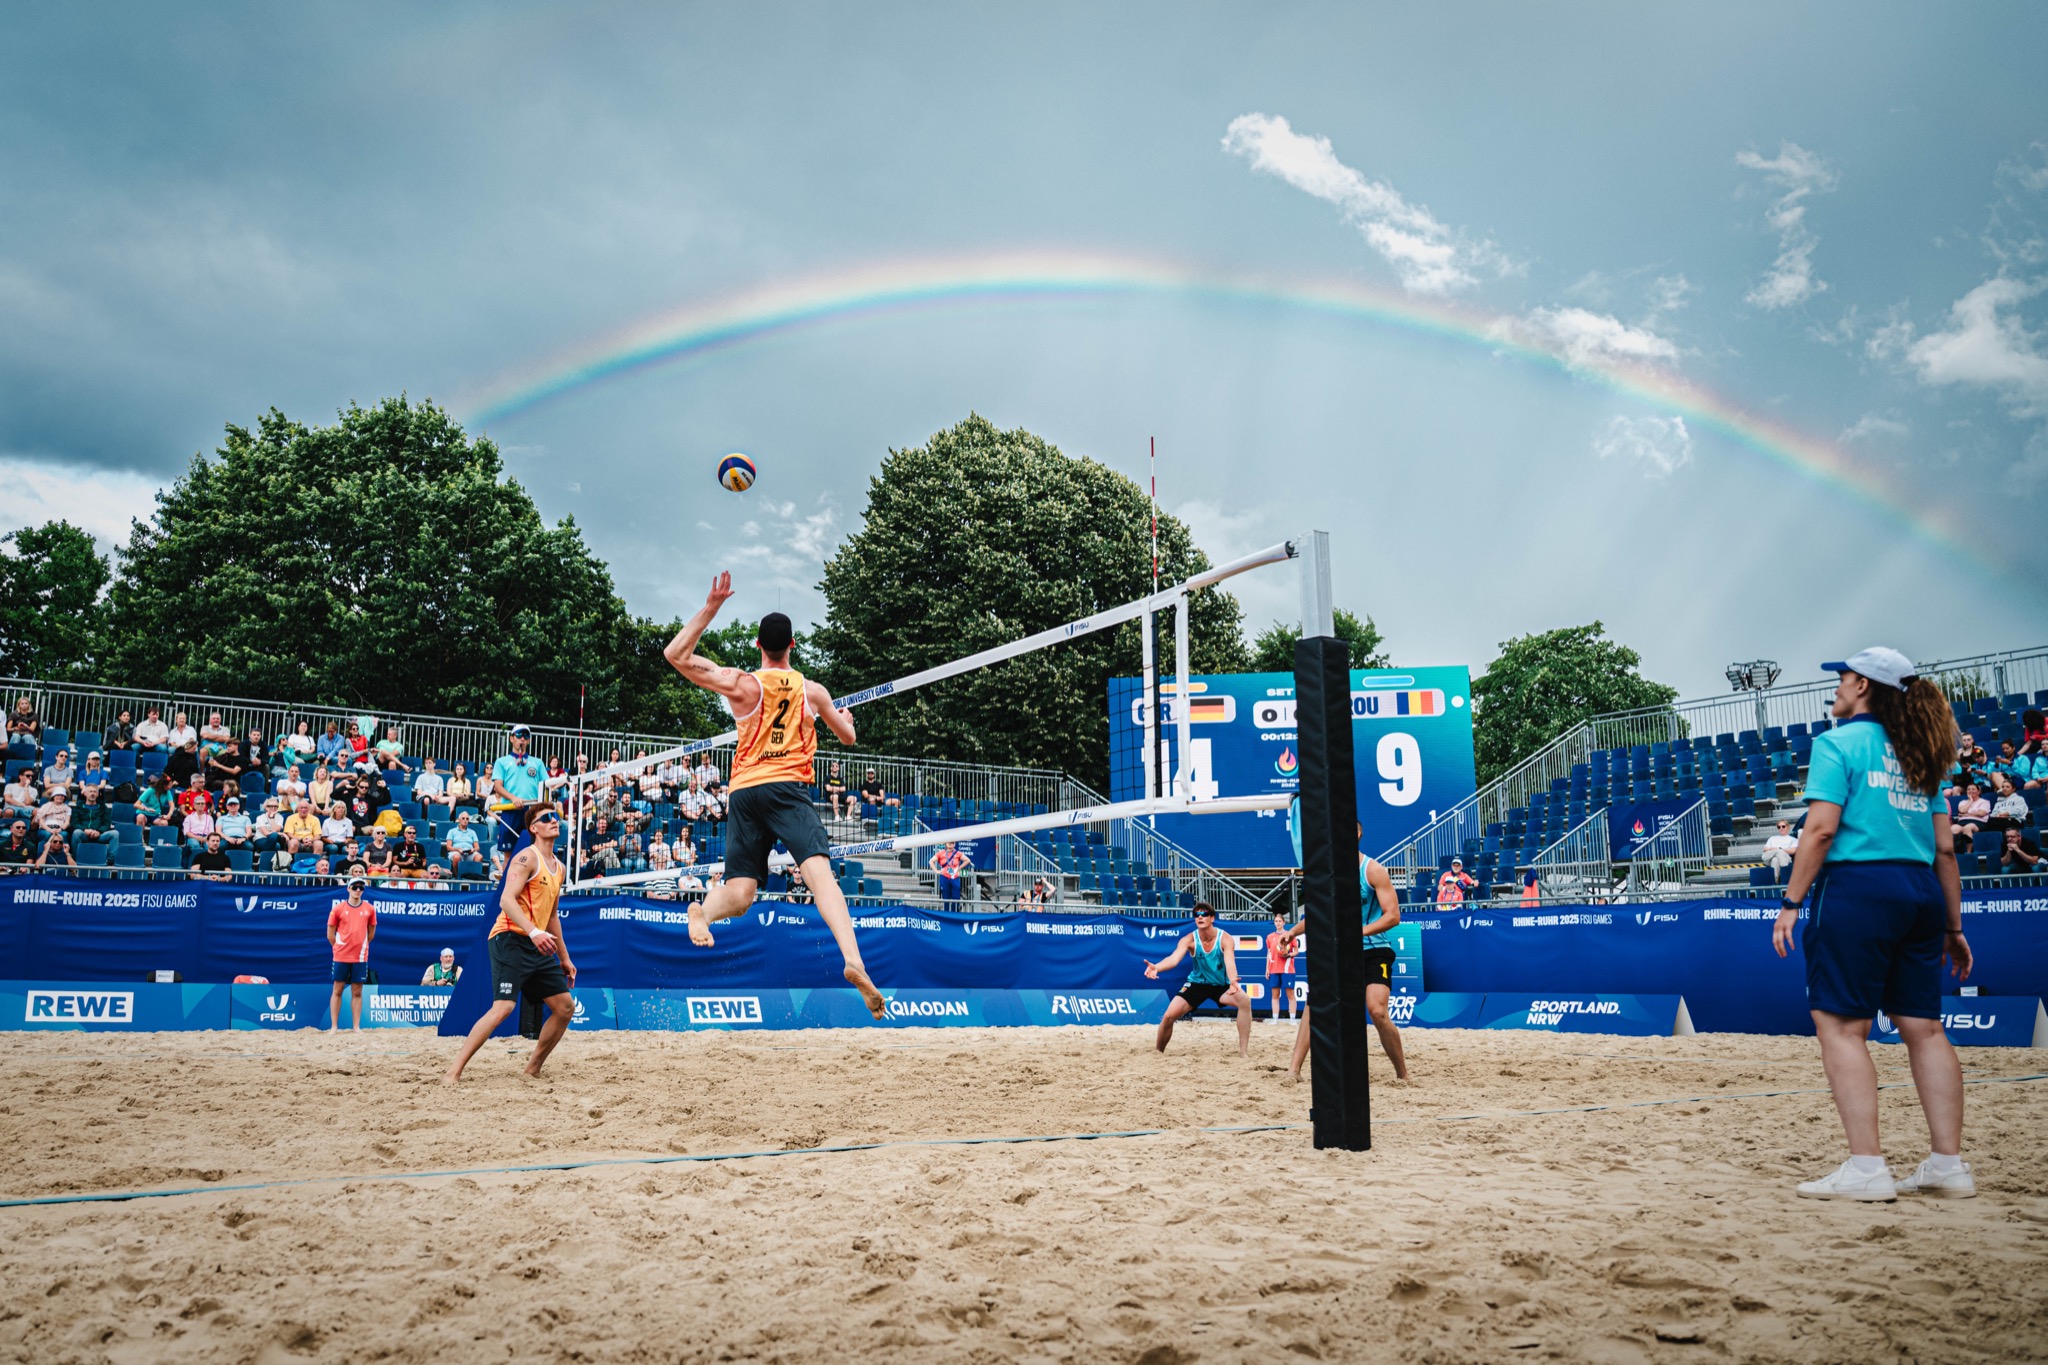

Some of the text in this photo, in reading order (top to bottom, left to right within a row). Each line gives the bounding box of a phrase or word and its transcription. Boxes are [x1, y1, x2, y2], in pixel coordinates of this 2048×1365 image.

[1075, 621, 1089, 632] FISU
[847, 688, 875, 704] UNIVERSITY
[875, 682, 894, 697] GAMES
[1266, 688, 1294, 696] SET
[772, 699, 790, 730] 2
[1262, 708, 1278, 723] 0
[771, 730, 784, 744] GER
[1261, 733, 1298, 741] 00:12:
[1376, 732, 1422, 807] 9
[1077, 811, 1093, 820] FISU
[846, 843, 875, 856] UNIVERSITY
[875, 840, 894, 851] GAMES
[13, 889, 197, 908] RHINE-RUHR 2025 FISU GAMES
[262, 900, 298, 911] FISU
[2024, 898, 2048, 912] 202
[408, 902, 437, 916] 2025
[439, 903, 457, 916] FISU
[458, 903, 485, 916] GAMES
[600, 907, 689, 924] RHINE-RUHR 2025
[1704, 909, 1780, 920] RHINE-RUHR 202
[777, 916, 805, 924] FISU
[885, 917, 907, 928] 2025
[907, 917, 920, 929] FISU
[921, 919, 941, 931] GAMES
[1426, 920, 1441, 930] GAMES
[1473, 919, 1494, 927] FISU
[1513, 914, 1612, 927] RHINE-RUHR 2025 FISU GAMES
[1654, 914, 1678, 922] FISU
[981, 925, 1004, 933] FISU
[1026, 922, 1124, 935] RHINE-RUHR 2025 FISU GAMES
[1398, 937, 1405, 950] 1
[1380, 963, 1388, 979] 1
[32, 995, 127, 1017] REWE
[370, 994, 451, 1009] RHINE-RUH
[890, 1001, 969, 1016] QIAODAN
[1078, 999, 1137, 1014] RIEDEL
[1530, 1000, 1621, 1014] SPORTLAND.
[370, 1010, 389, 1022] FISU
[390, 1010, 420, 1022] WORLD
[692, 1001, 757, 1019] REWE
[260, 1013, 296, 1022] FISU
[1526, 1012, 1564, 1025] NRW
